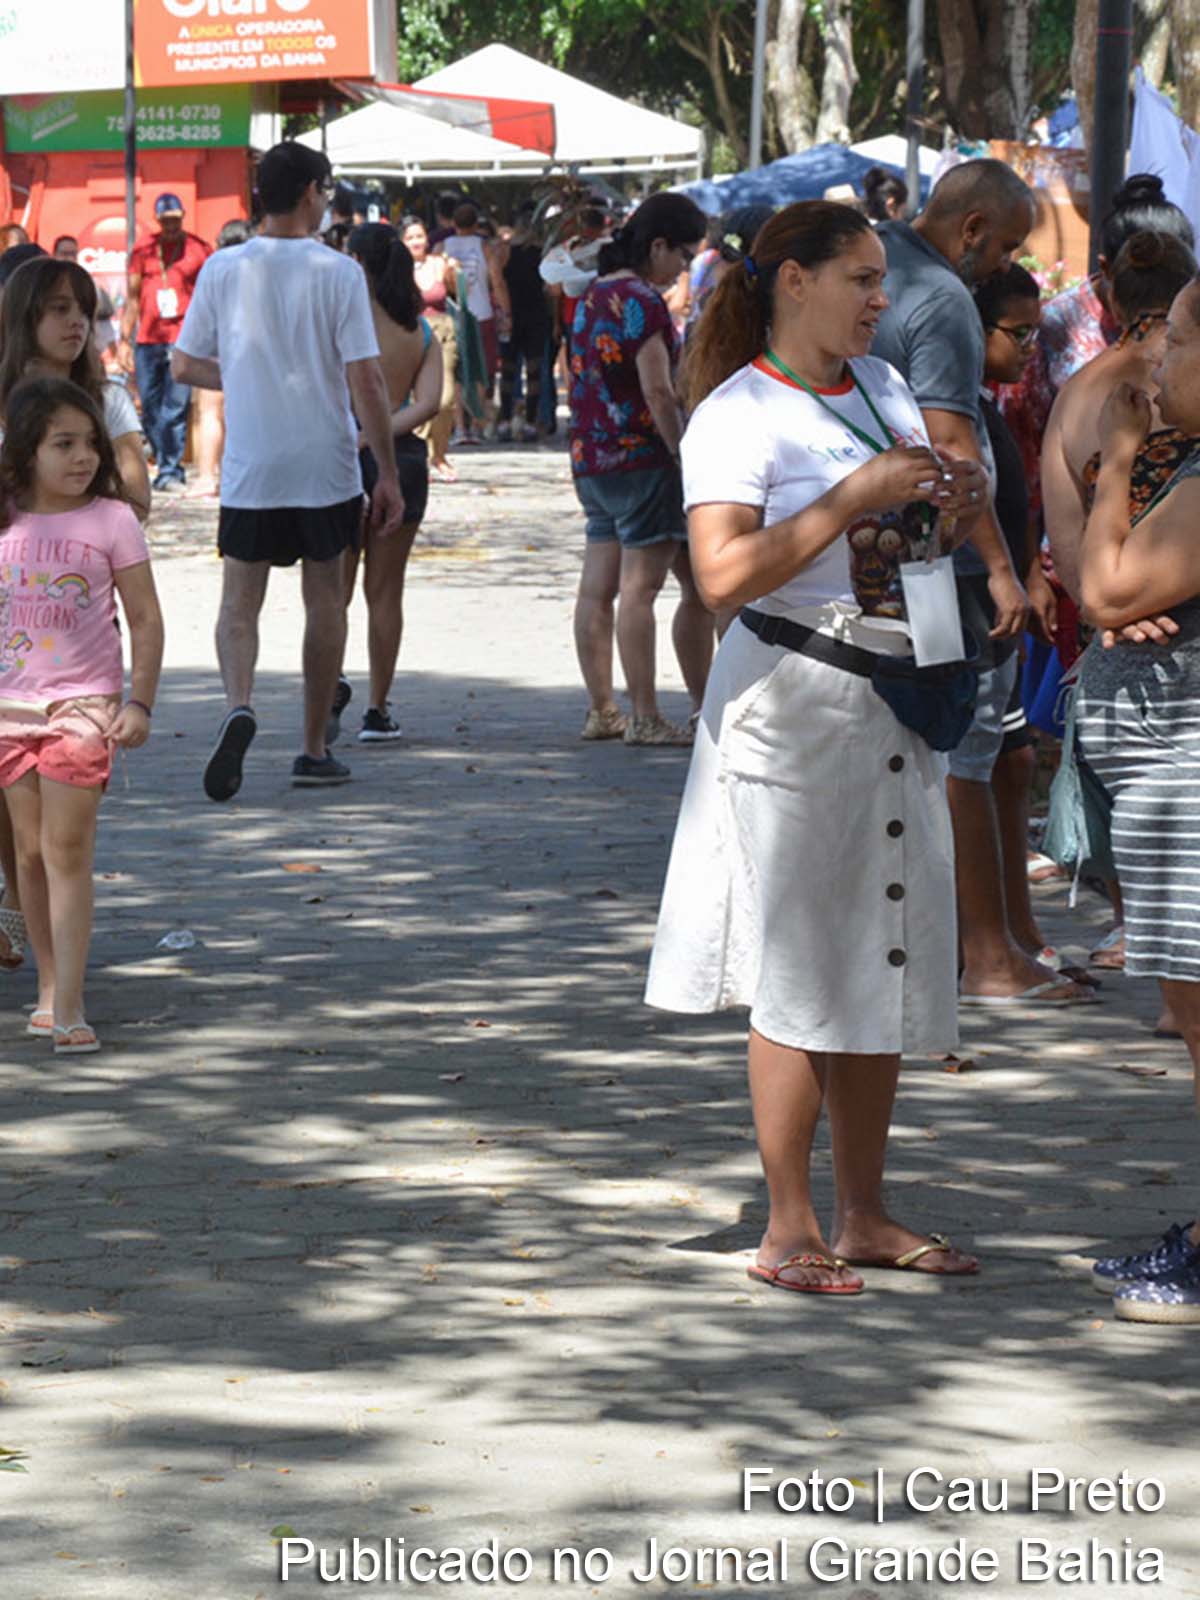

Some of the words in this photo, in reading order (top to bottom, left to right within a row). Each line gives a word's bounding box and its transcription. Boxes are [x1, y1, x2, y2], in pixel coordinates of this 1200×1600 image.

[178, 26, 190, 39] A
[235, 19, 325, 36] OPERADORA
[166, 40, 240, 56] PRESENTE
[242, 38, 264, 52] EM
[266, 36, 313, 50] TODOS
[314, 35, 336, 49] OS
[260, 53, 281, 68] DA
[284, 52, 326, 66] BAHIA
[106, 116, 126, 132] 75
[136, 105, 221, 121] 4141-0730
[36, 538, 73, 565] LIKE
[81, 543, 91, 567] A
